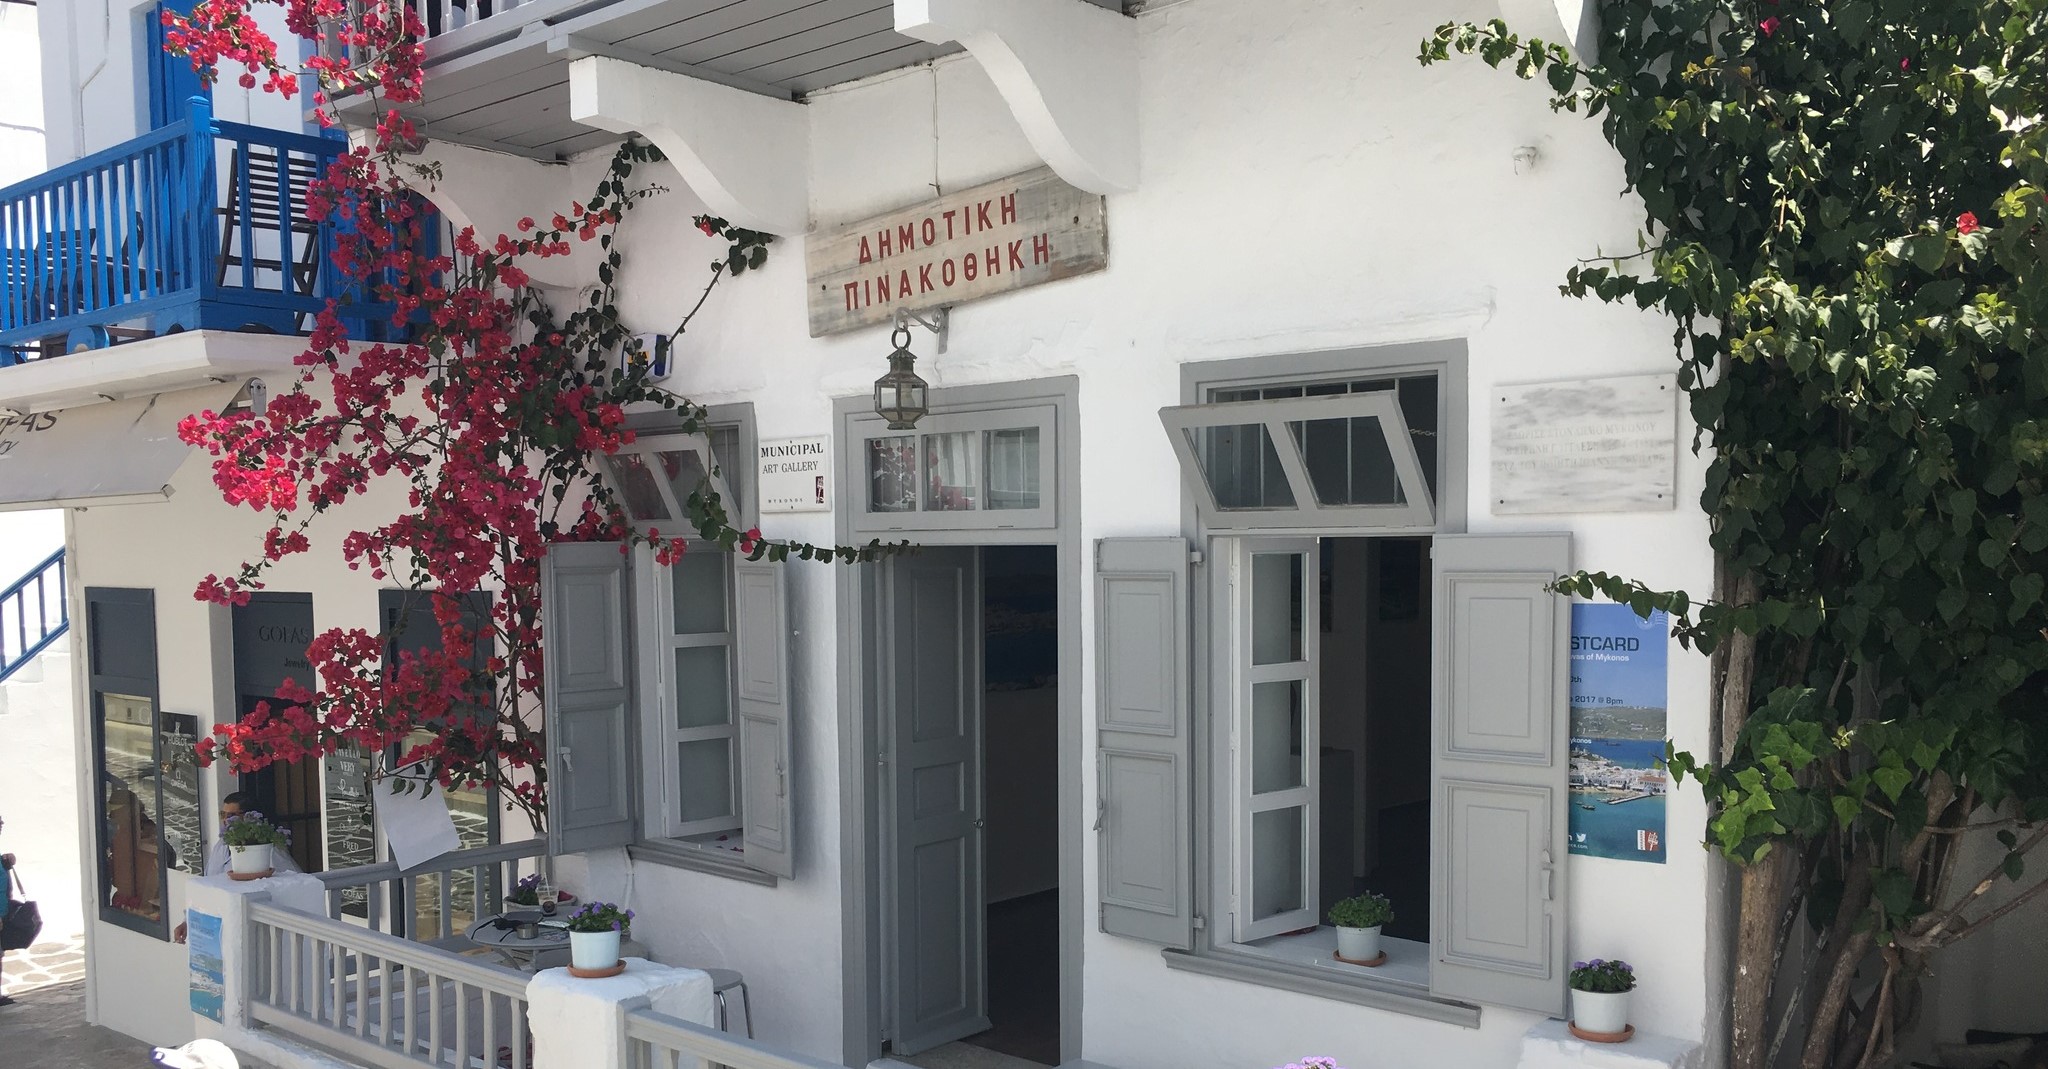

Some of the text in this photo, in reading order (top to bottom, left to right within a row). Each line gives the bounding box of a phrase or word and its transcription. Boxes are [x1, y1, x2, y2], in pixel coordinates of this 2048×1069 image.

[859, 193, 1016, 264] ΔΗΜΟΤΙΚΗ
[844, 233, 1049, 311] ΠΙΝΑΚΟΘΗΚΗ
[761, 443, 824, 458] MUNICIPAL
[763, 461, 818, 474] ART GALLERY
[1595, 653, 1630, 662] Mykonos
[1575, 695, 1596, 703] 2017
[1606, 697, 1623, 705] 8pm
[343, 840, 359, 852] FRED
[341, 889, 364, 900] GOFAS
